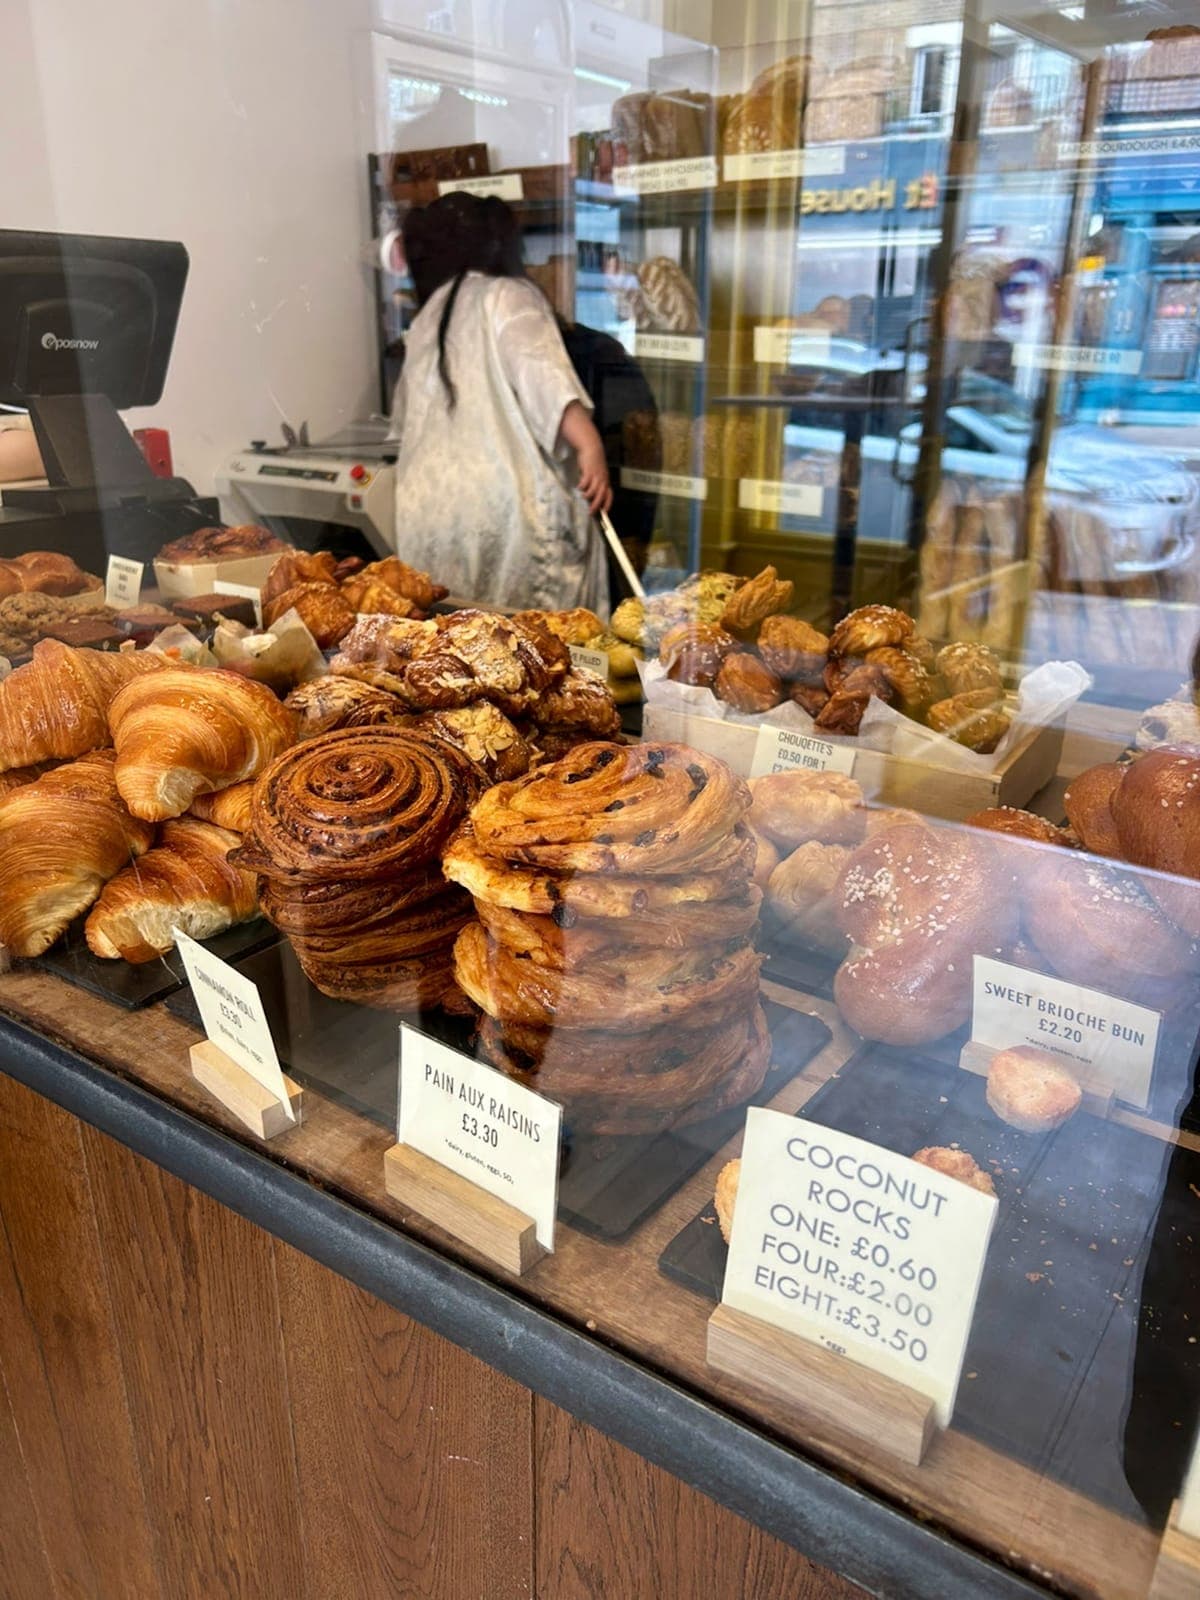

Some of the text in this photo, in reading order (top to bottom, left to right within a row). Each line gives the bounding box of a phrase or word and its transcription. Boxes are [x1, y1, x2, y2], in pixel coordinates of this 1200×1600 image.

[777, 748, 801, 765] £0.50
[802, 756, 819, 769] FOR
[984, 982, 1145, 1046] SWEET BRIOCHE BUN
[1038, 1018, 1082, 1043] £2.20
[425, 1063, 541, 1143] PAIN AUX RAISINS
[462, 1113, 498, 1148] £3.30
[786, 1137, 948, 1217] COCONUT
[807, 1180, 912, 1240] ROCKS
[770, 1204, 937, 1291] ONE: £0.60
